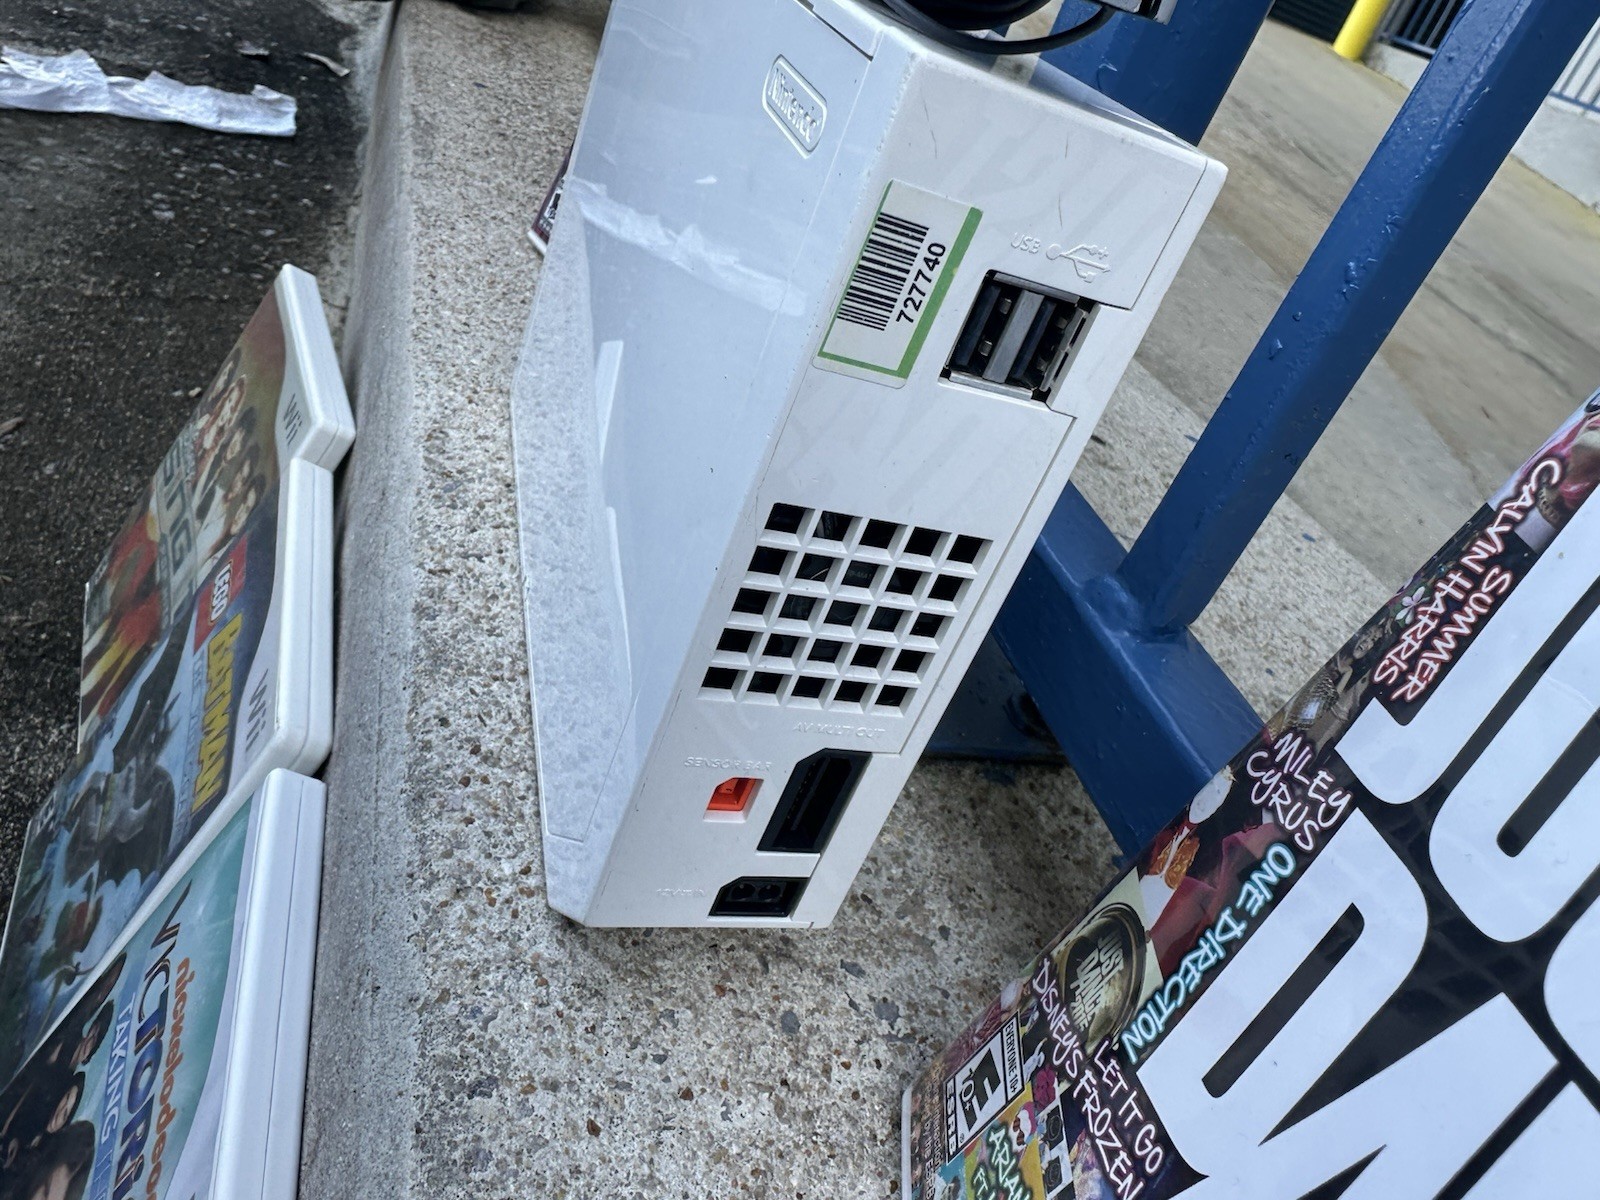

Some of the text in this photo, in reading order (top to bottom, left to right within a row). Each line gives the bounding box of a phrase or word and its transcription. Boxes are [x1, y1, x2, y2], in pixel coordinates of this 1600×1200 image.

[767, 66, 817, 143] Nintendo
[896, 242, 946, 324] 727740
[1010, 232, 1041, 254] USB
[283, 393, 302, 447] Wii
[211, 562, 232, 624] LEGO
[1373, 458, 1561, 685] CALVIN HARRIS
[1390, 566, 1513, 702] SUMMER
[191, 612, 243, 817] BATMAN
[246, 668, 269, 753] Wii
[684, 756, 741, 771] SENSOR
[1246, 750, 1320, 851] CYRUS
[1273, 732, 1352, 828] MILEY
[1120, 843, 1295, 1065] ONE DIRECTION
[101, 991, 136, 1145] TAKING
[1005, 1021, 1018, 1093] EVERYONE 10+
[1032, 957, 1144, 1200] DISNEY'S FROZEN
[946, 1078, 957, 1156] ESRB
[1094, 1040, 1164, 1174] LET IT GO
